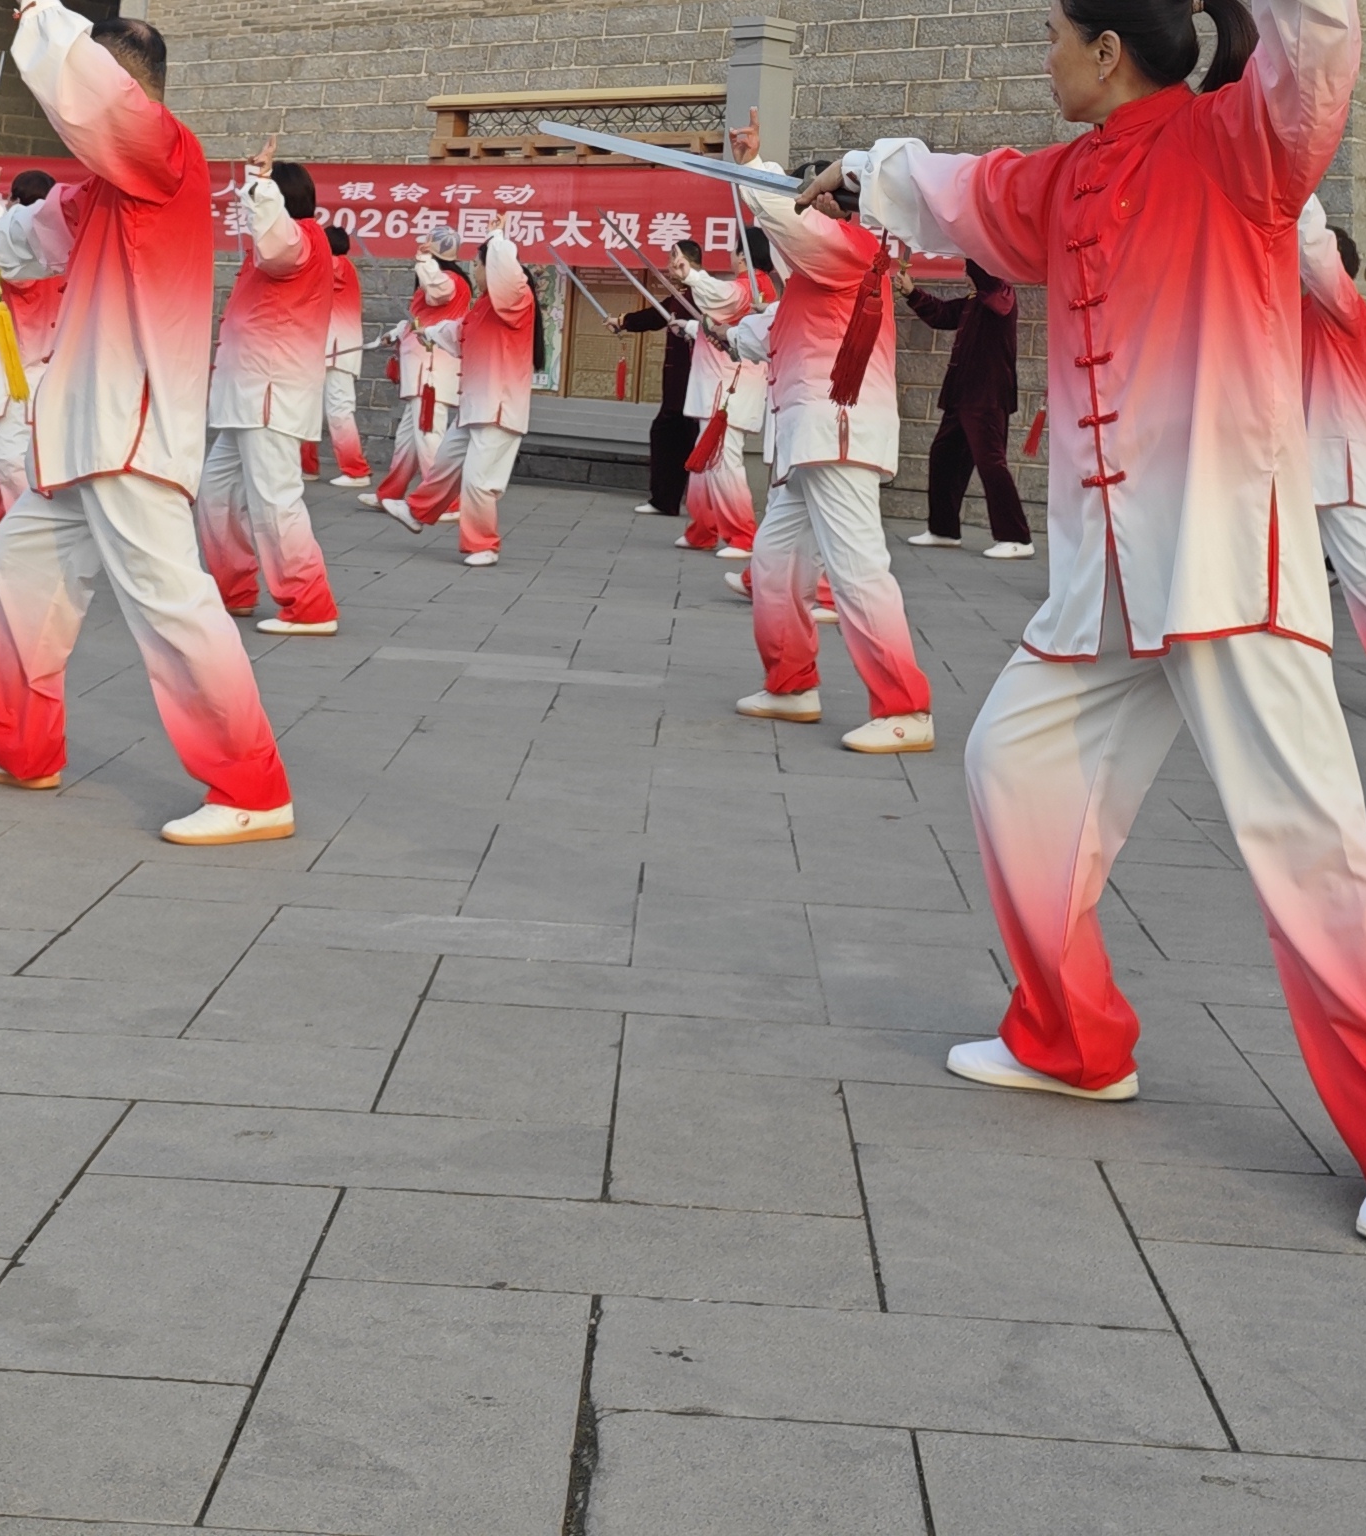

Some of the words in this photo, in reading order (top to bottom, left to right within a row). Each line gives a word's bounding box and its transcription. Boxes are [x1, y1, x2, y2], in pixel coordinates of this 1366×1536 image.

[338, 181, 536, 205] 银铃行动
[314, 207, 736, 252] 2026年国际太极拳日
